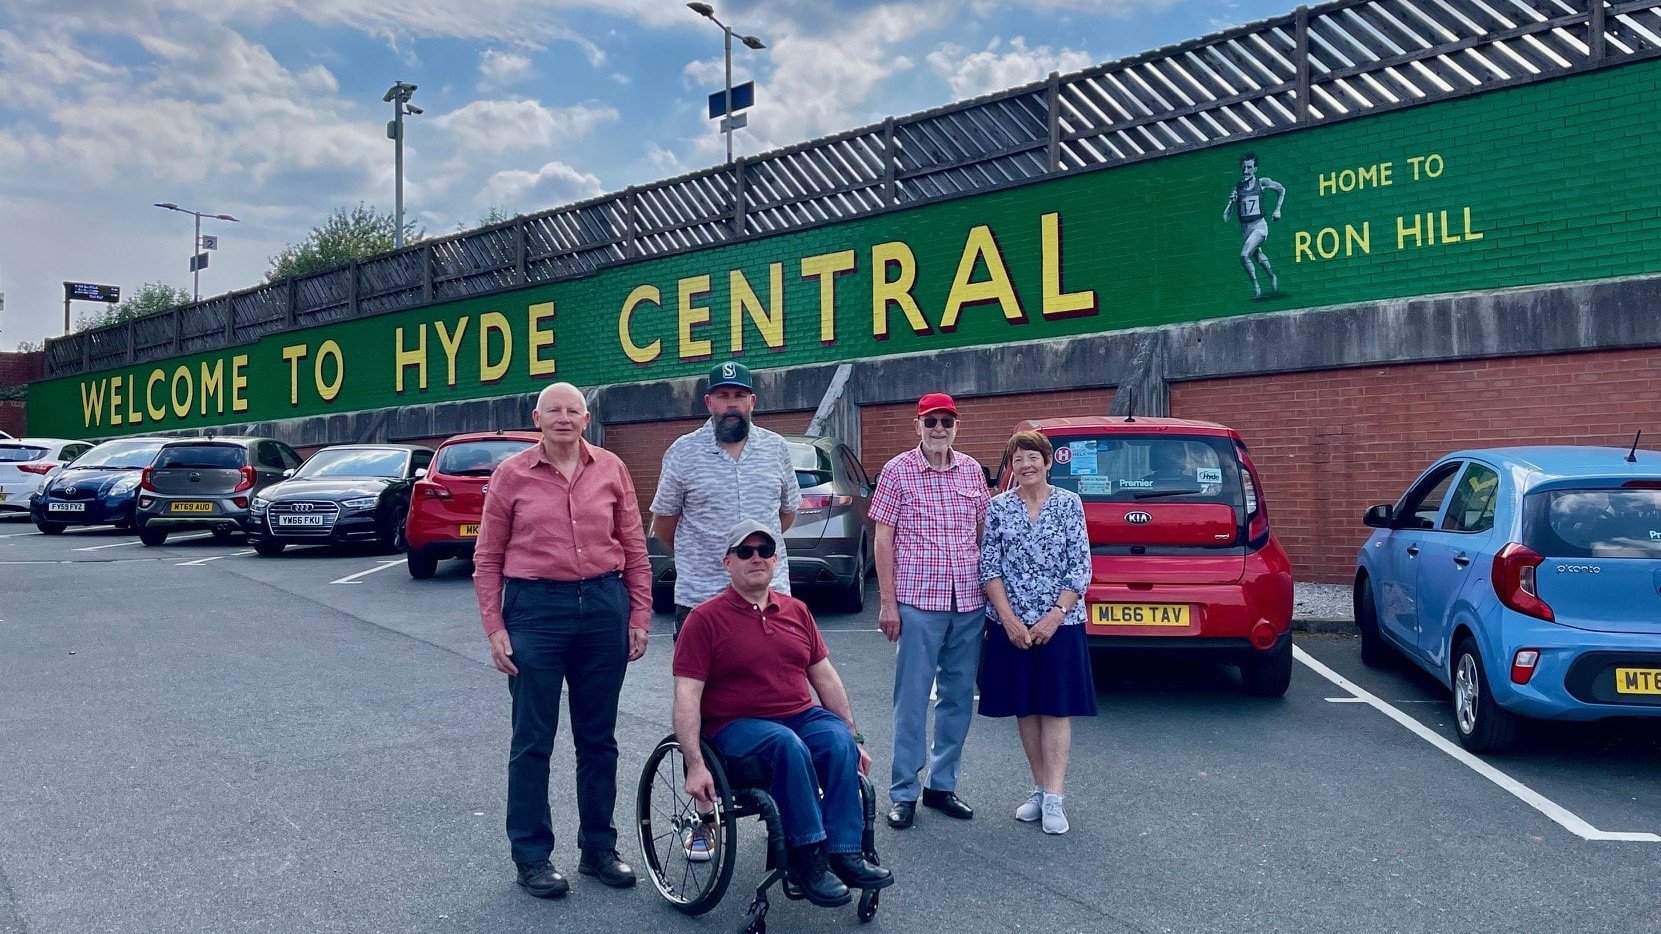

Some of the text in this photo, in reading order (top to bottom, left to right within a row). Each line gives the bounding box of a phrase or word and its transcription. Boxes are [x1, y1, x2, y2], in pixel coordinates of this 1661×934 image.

[1319, 153, 1444, 197] HOME TO
[1243, 199, 1256, 214] 17
[1295, 206, 1484, 263] RON HILL
[81, 212, 1098, 429] WELCOME TO HYDE CENTRAL
[722, 362, 737, 379] S
[1120, 478, 1154, 487] Premier
[304, 516, 320, 525] FKU
[1128, 513, 1148, 523] KIA
[1098, 606, 1182, 623] ML66 TAV
